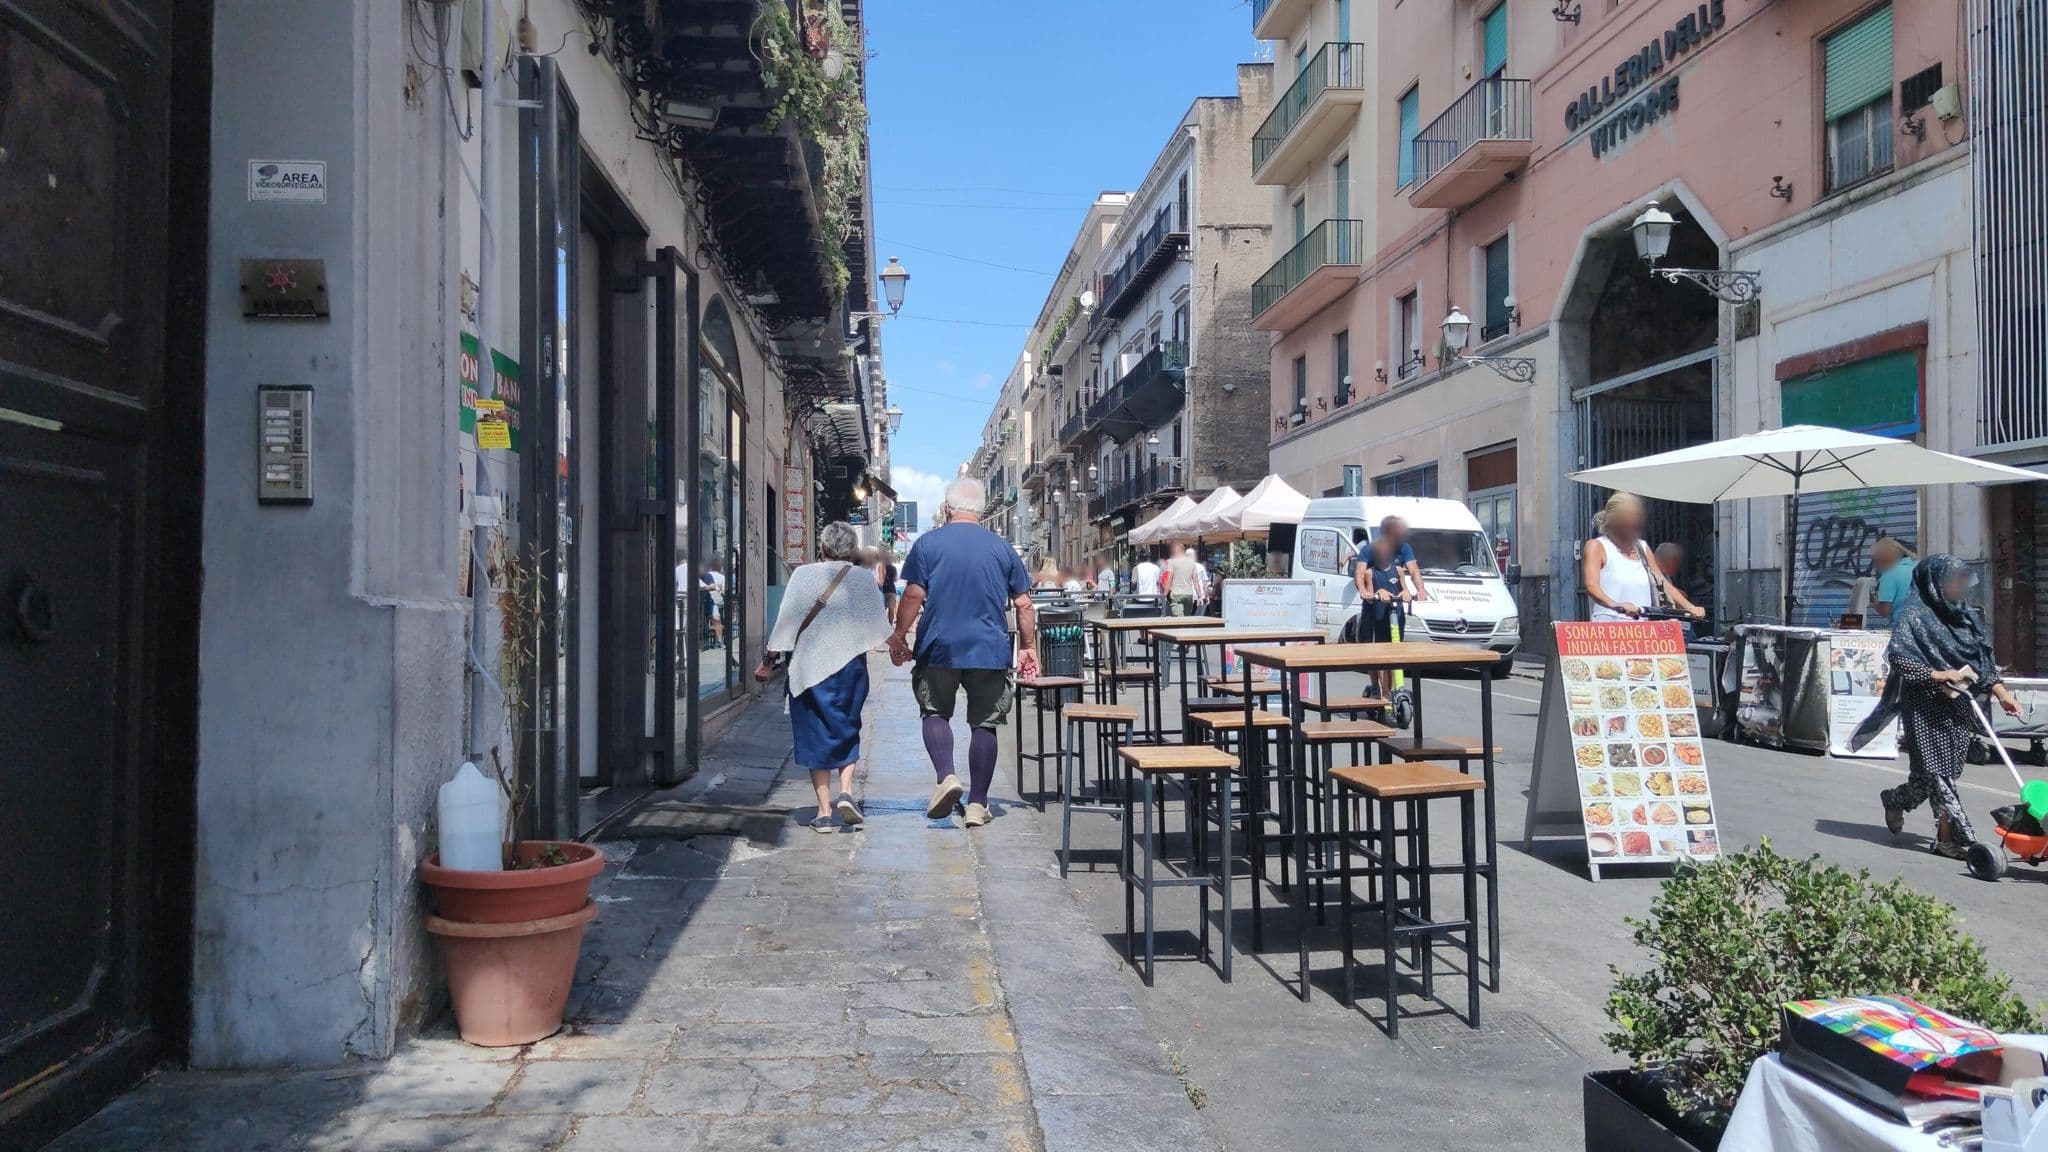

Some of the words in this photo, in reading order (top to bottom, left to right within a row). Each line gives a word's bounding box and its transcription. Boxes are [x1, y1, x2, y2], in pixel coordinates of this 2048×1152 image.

[1565, 38, 1663, 131] GALLERIA
[1664, 0, 1726, 61] DELLE
[1590, 75, 1680, 160] VITTORIE
[282, 173, 319, 183] AREA
[1565, 625, 1606, 640] SONAR
[1609, 624, 1657, 640] BANGLA
[1567, 641, 1610, 654] INDIAN
[1613, 640, 1640, 654] FAST
[1645, 639, 1677, 653] FOOD
